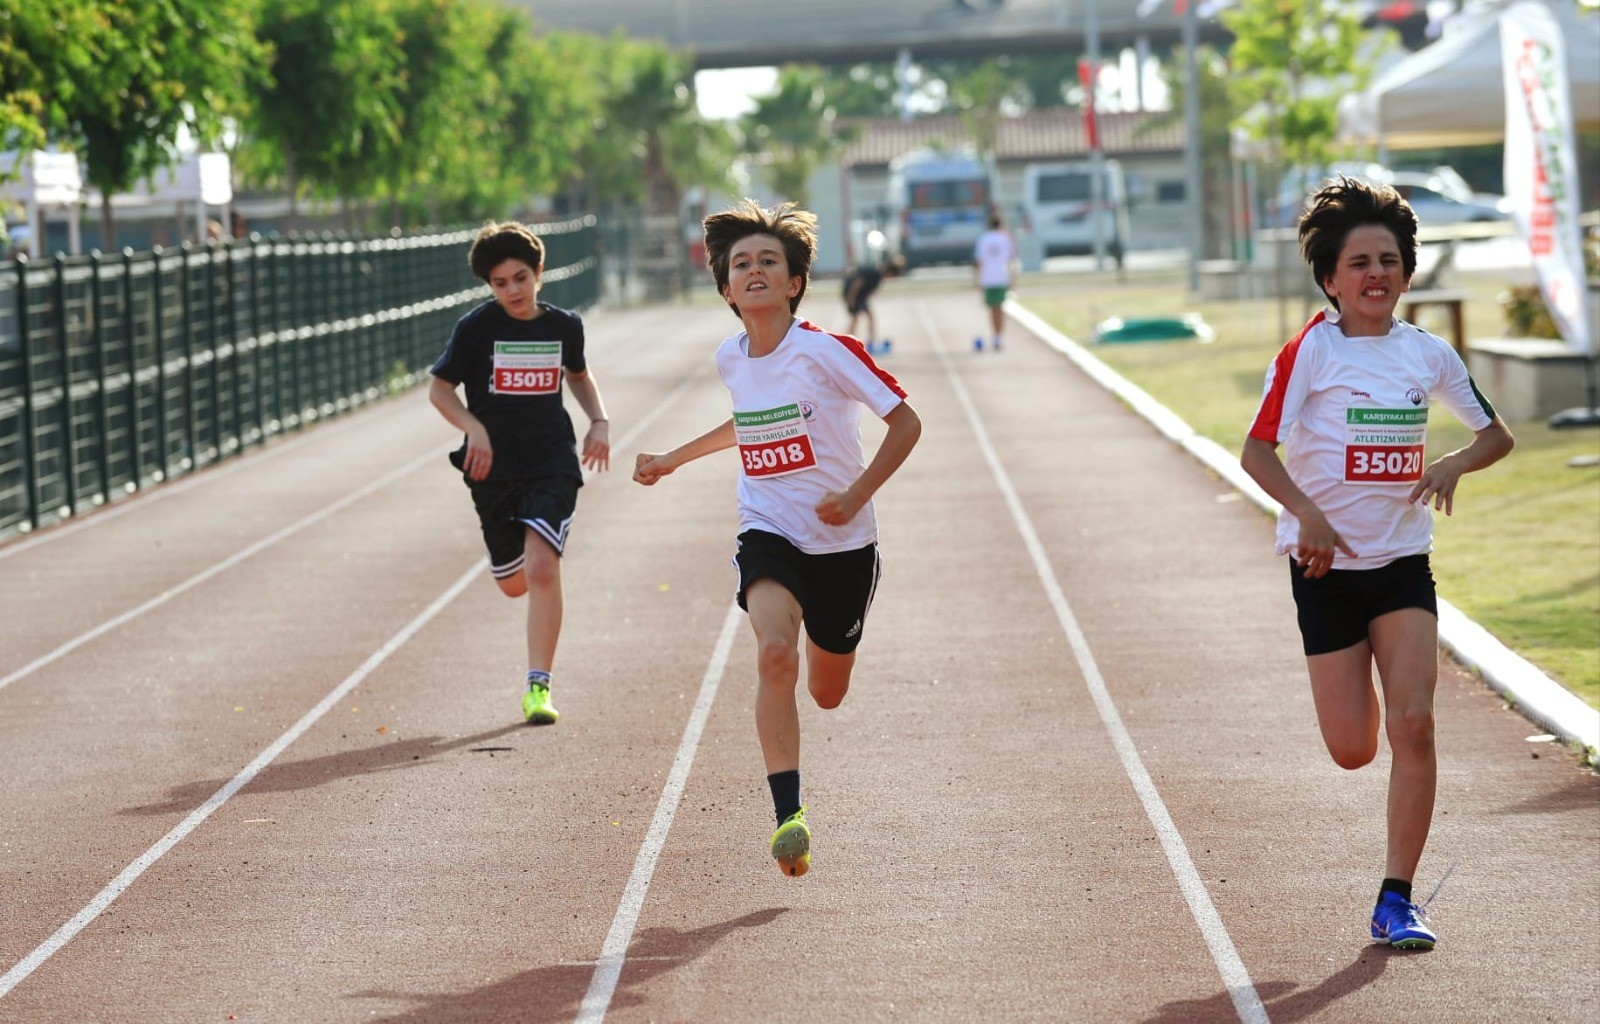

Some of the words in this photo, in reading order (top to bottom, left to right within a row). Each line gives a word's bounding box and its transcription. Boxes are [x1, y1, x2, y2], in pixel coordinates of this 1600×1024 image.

[501, 371, 554, 388] 35013
[763, 408, 799, 421] BELEDİYESİ
[1363, 413, 1404, 422] KARŞIYAKA
[761, 428, 799, 440] YARIŞLARI
[1354, 433, 1396, 443] ATLETİZM
[743, 443, 805, 469] 35018
[1352, 451, 1421, 474] 35020
